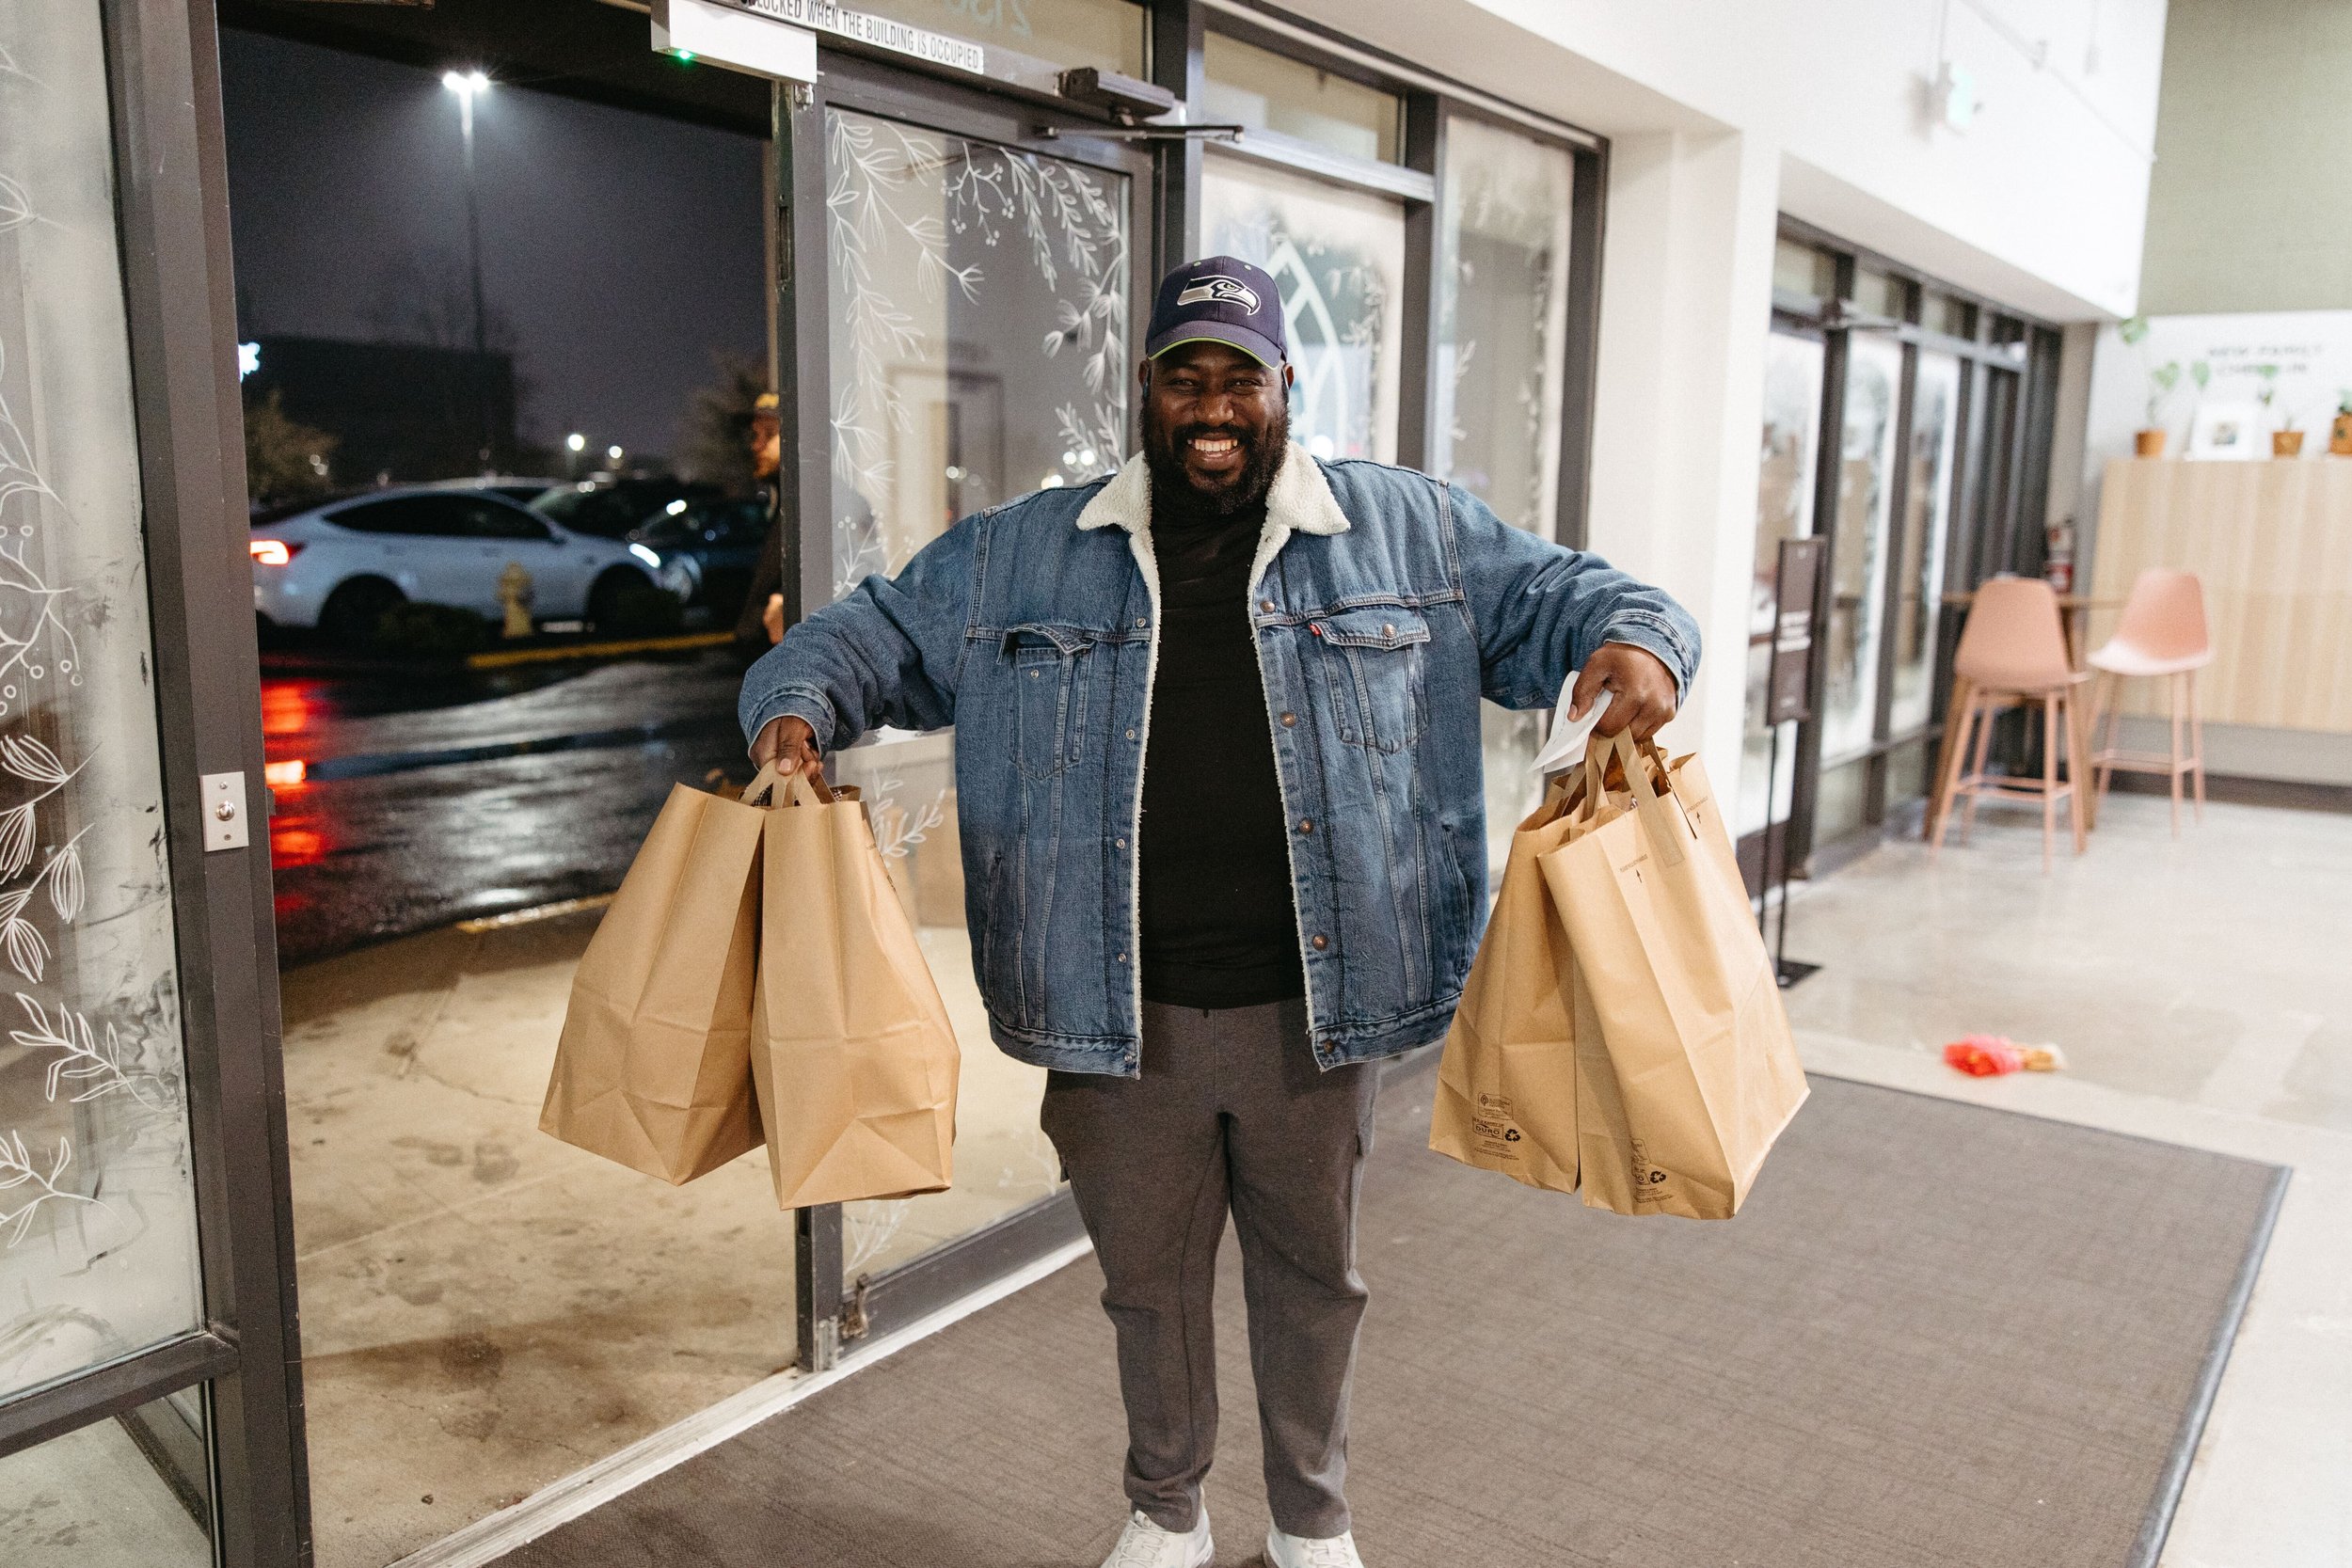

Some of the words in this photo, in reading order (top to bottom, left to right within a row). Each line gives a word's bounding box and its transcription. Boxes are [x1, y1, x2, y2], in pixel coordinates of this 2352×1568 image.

[806, 0, 839, 30] WHEN
[842, 10, 863, 37] THE
[866, 18, 914, 52] BUILDING
[917, 32, 927, 55] IS
[930, 37, 979, 69] OCCUPIED
[1475, 1125, 1501, 1135] DURO
